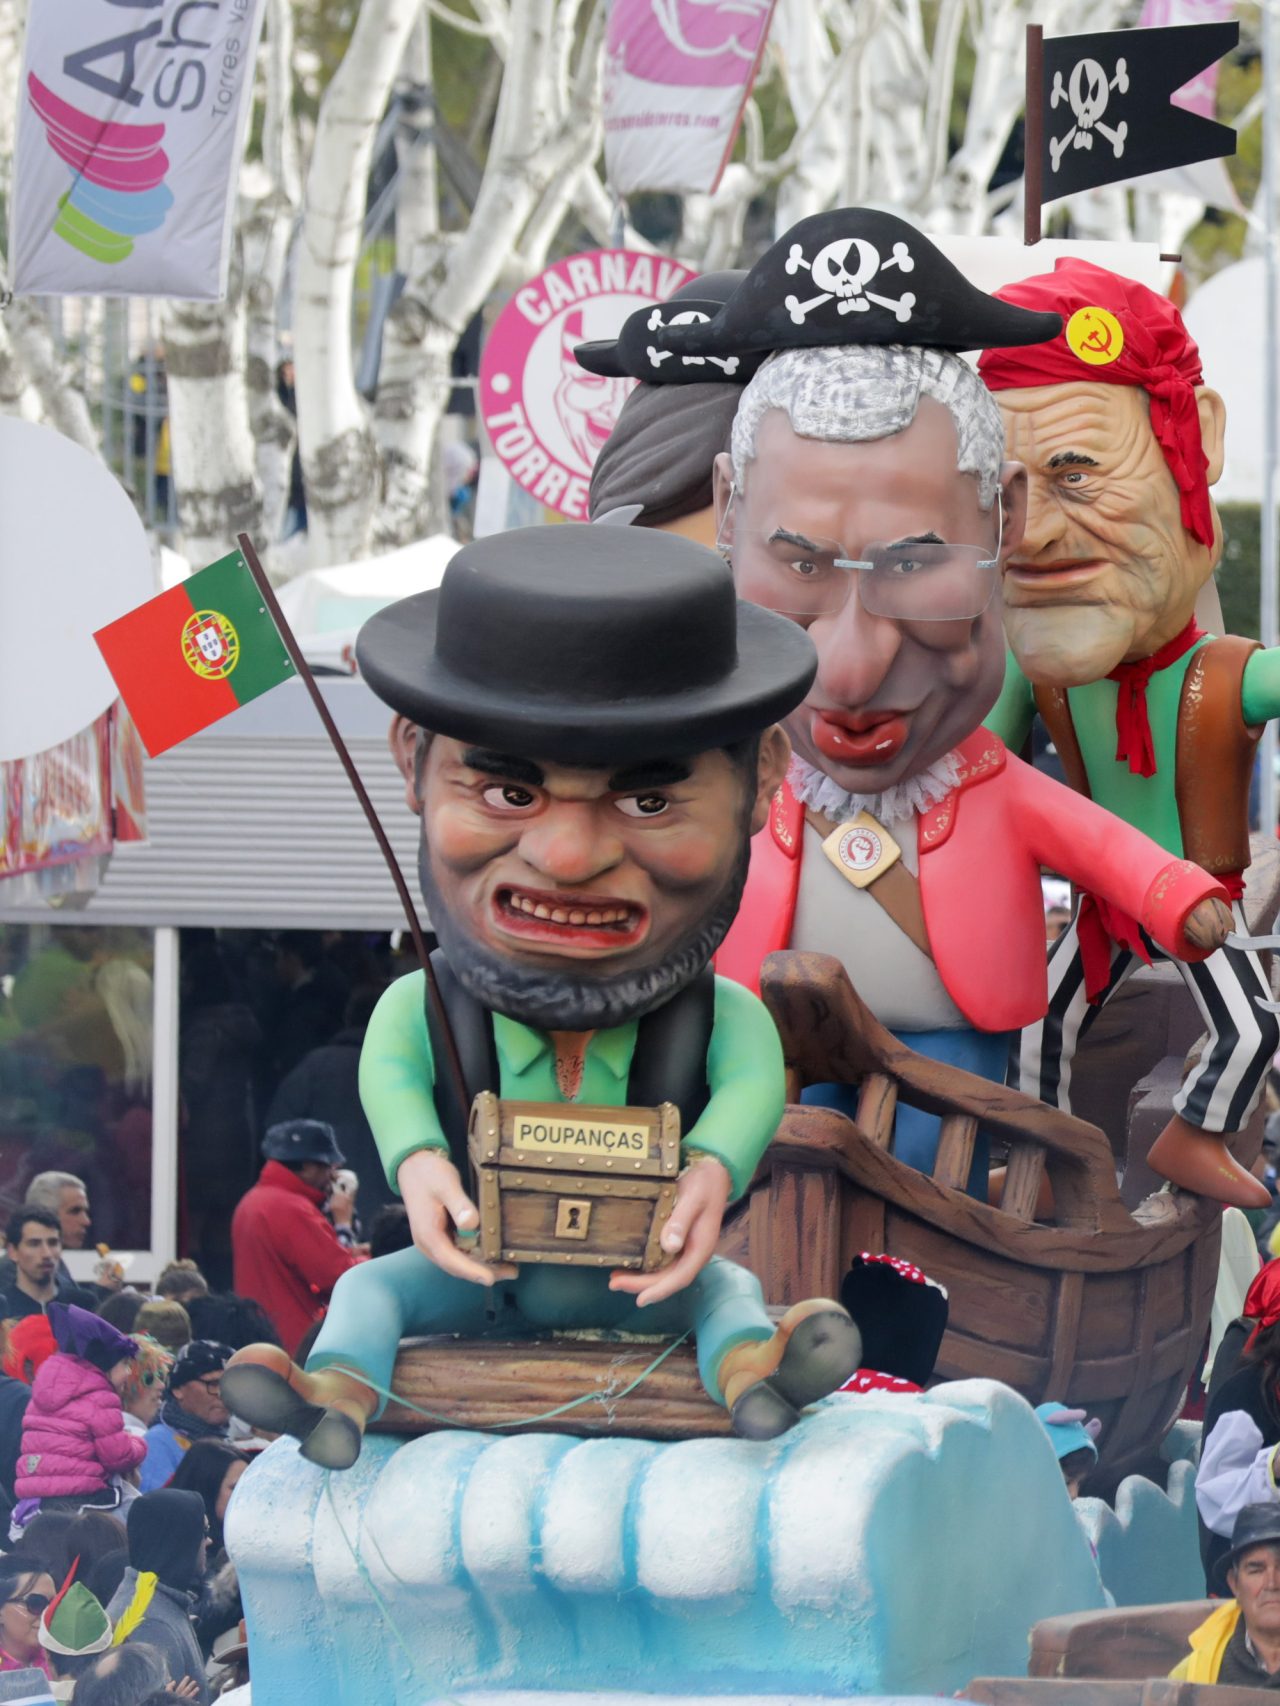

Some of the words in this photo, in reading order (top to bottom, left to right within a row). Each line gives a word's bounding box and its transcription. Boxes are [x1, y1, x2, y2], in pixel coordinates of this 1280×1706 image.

[63, 0, 165, 107] A
[212, 39, 241, 118] Torres
[486, 402, 591, 520] TORRE
[520, 1124, 644, 1153] POUPANÇAS
